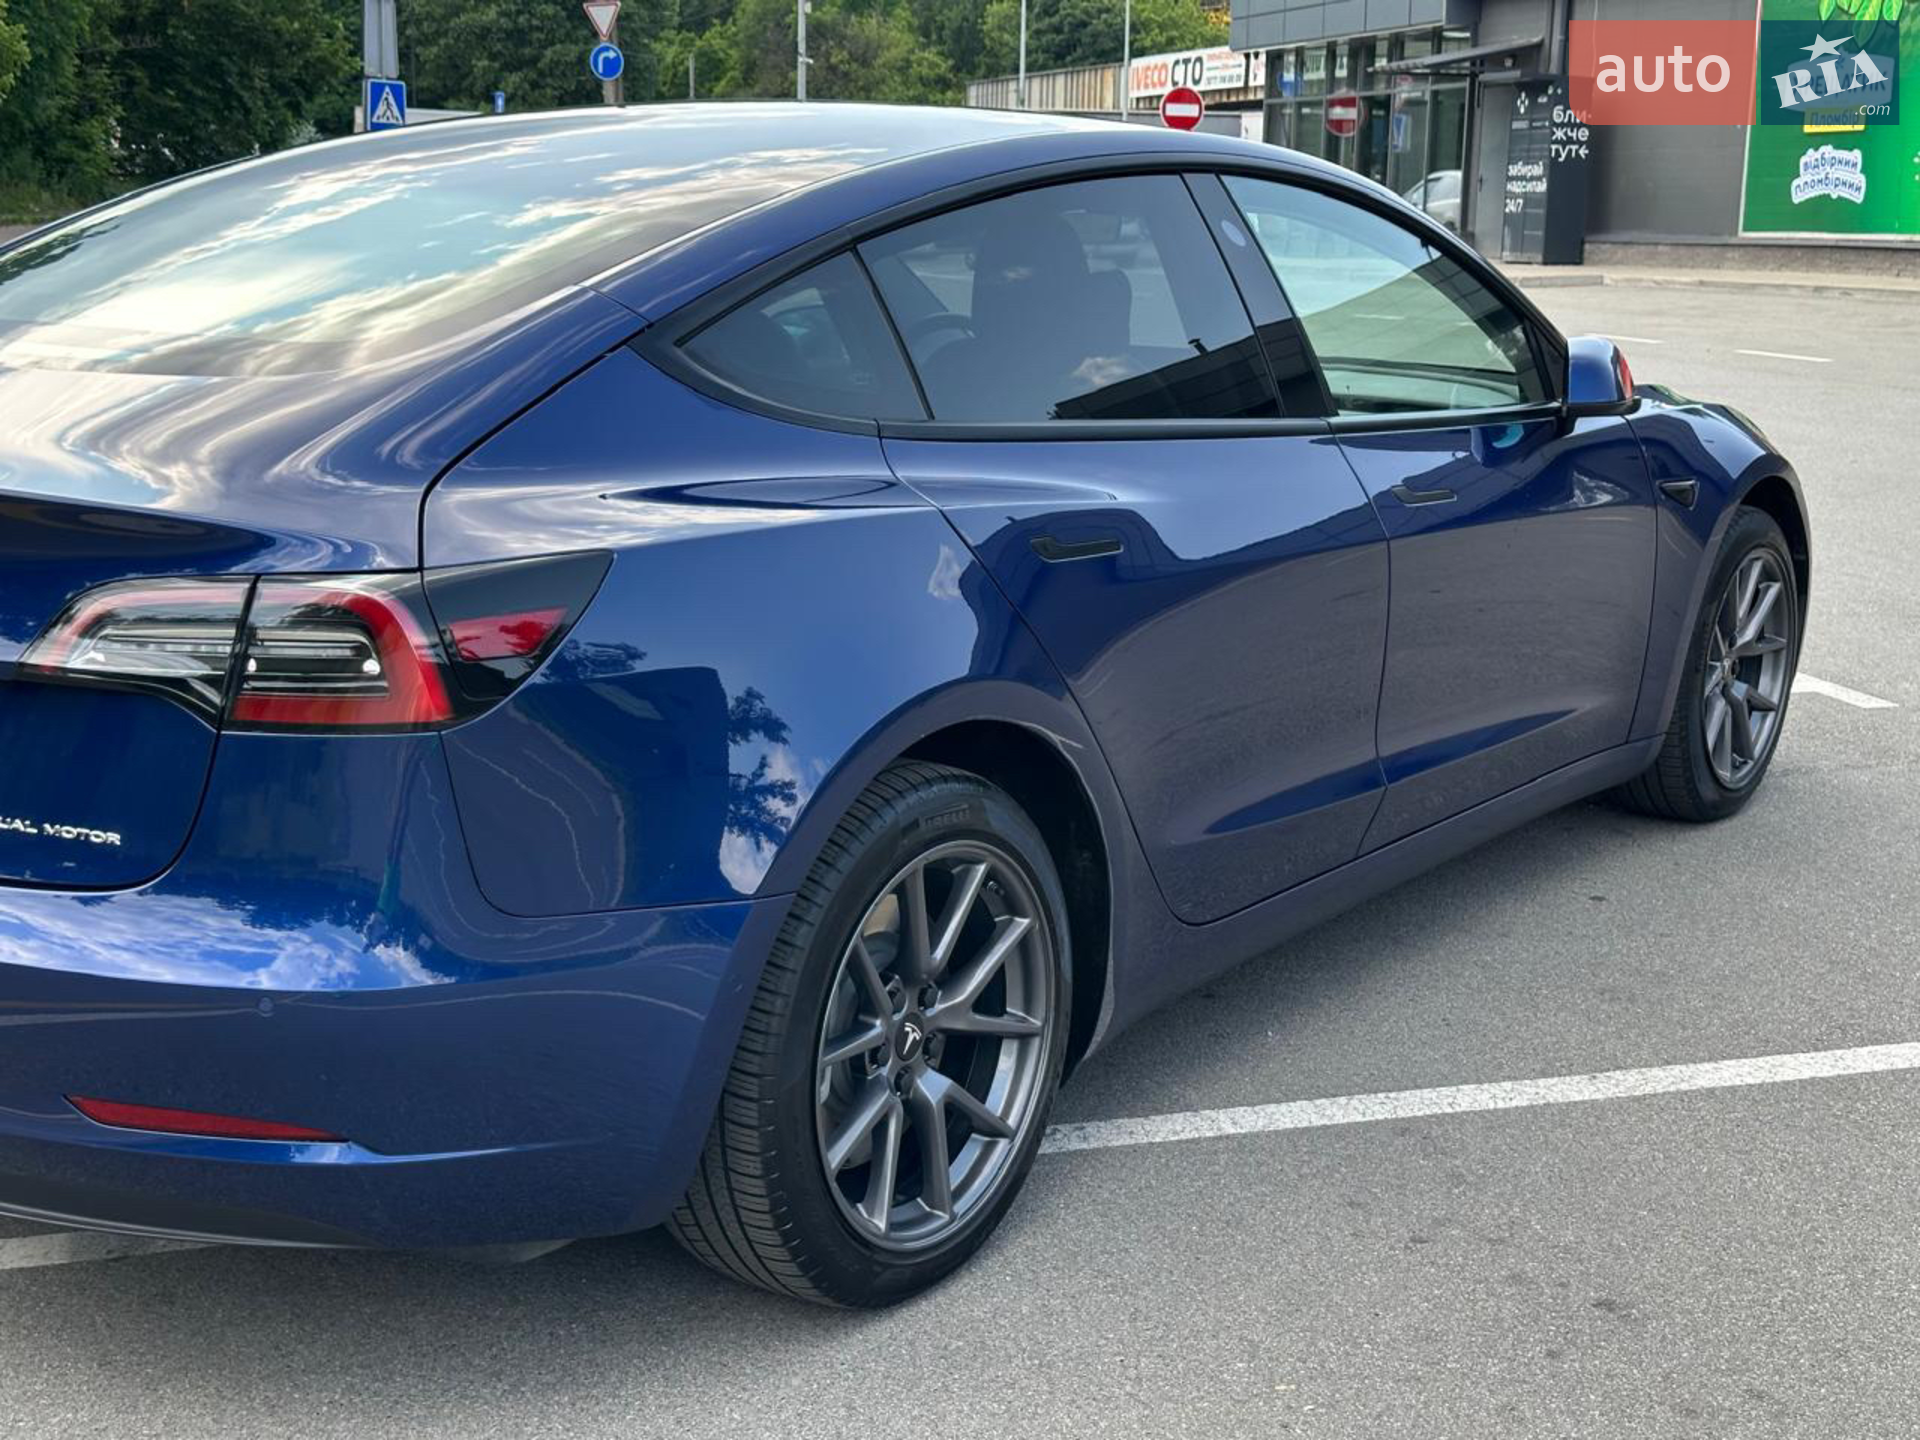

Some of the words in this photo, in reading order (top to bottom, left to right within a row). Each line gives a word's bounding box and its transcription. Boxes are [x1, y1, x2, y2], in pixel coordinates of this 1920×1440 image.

[1131, 62, 1169, 91] IVECO
[1171, 56, 1204, 87] СТО
[1552, 126, 1590, 142] жче
[1504, 198, 1525, 213] 24/7
[42, 822, 121, 846] MOTOR
